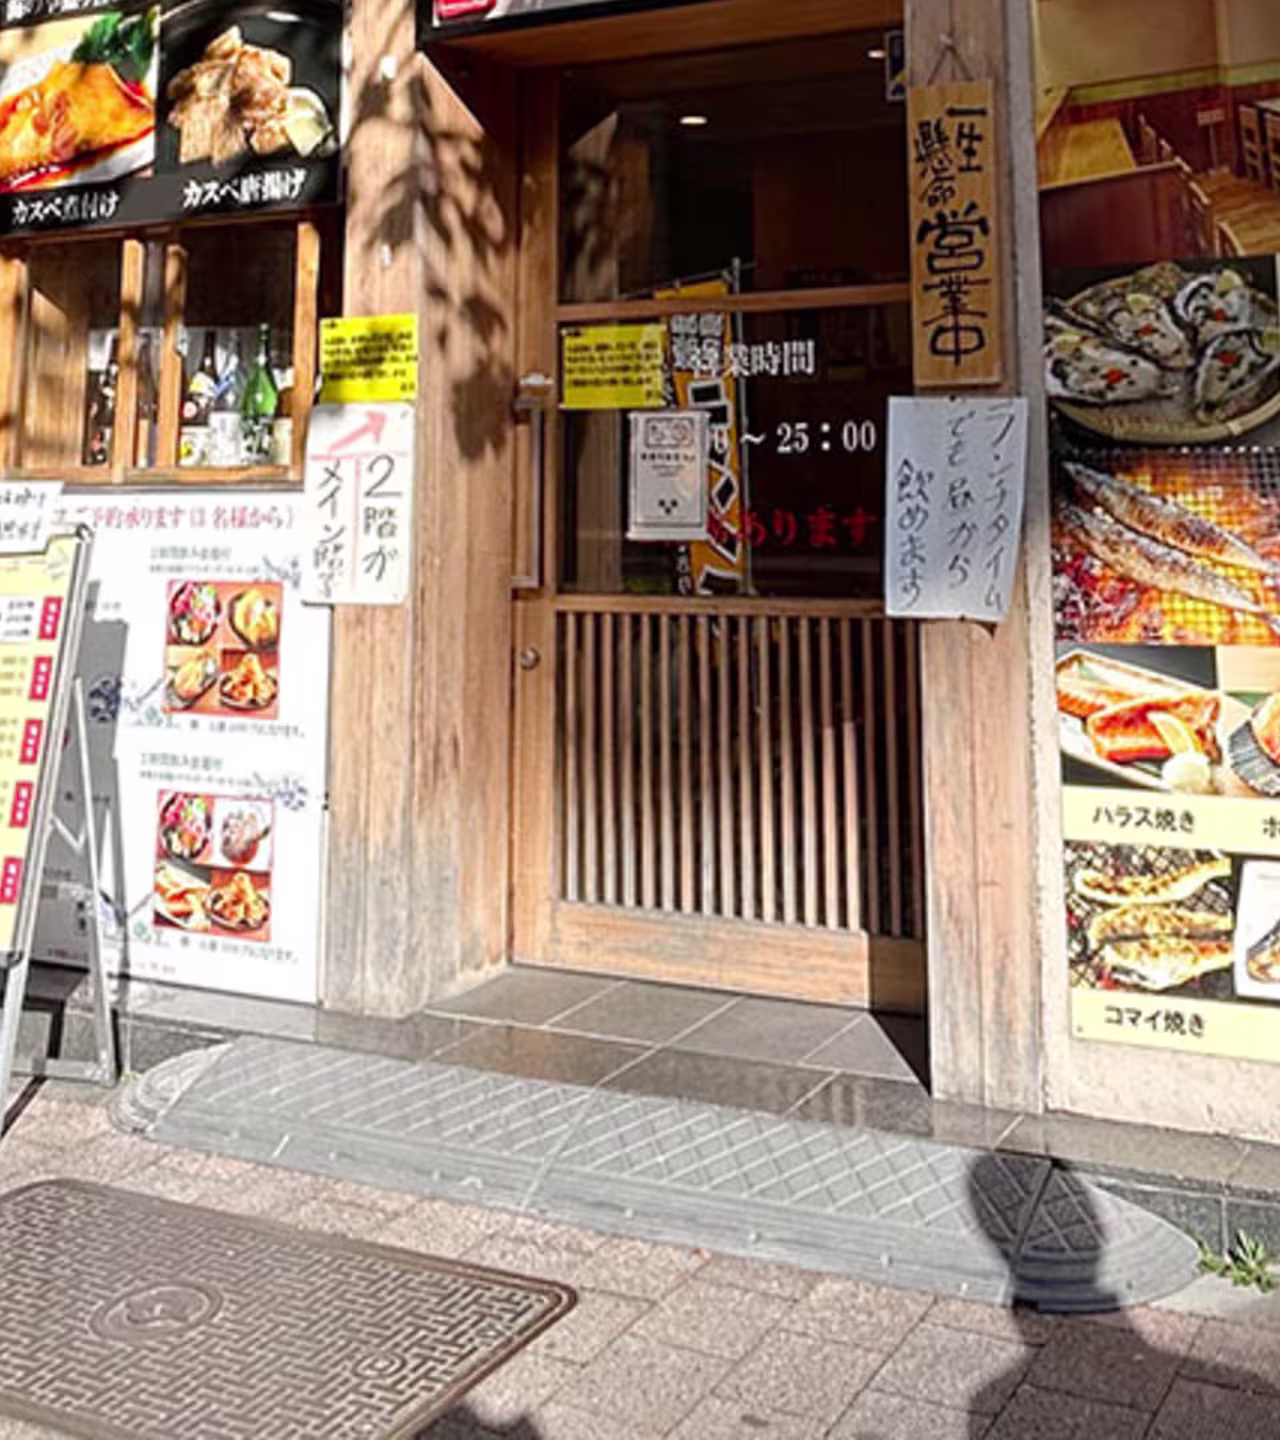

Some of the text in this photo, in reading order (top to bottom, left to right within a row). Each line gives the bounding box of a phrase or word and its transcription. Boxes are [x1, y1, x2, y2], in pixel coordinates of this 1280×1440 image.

[916, 200, 991, 367] 営業中
[1092, 805, 1196, 833] ハラス焼き
[1104, 1004, 1206, 1039] コマイ焼き
